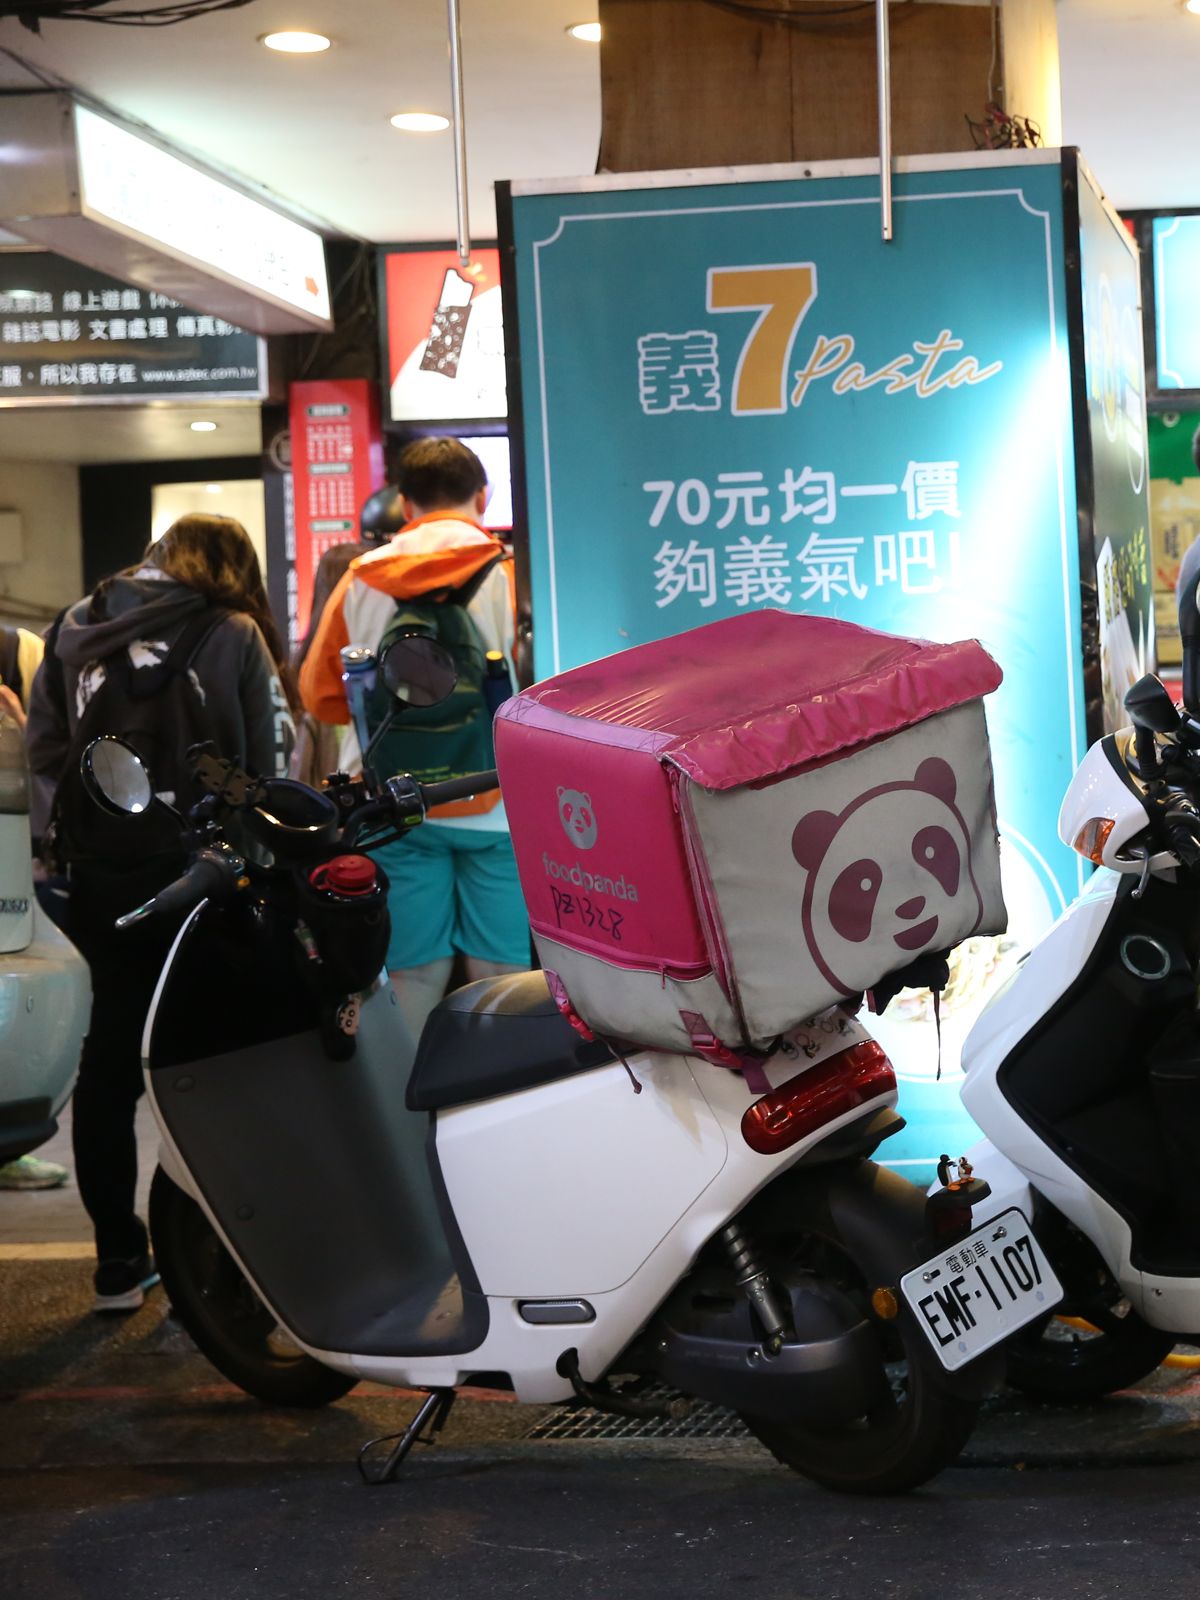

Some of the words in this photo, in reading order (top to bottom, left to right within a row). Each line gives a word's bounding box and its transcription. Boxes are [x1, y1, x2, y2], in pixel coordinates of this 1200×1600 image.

[791, 329, 1002, 407] Pasta
[643, 460, 961, 530] 70元均一價
[542, 851, 638, 902] foodpanda
[945, 1240, 989, 1273] 電動車
